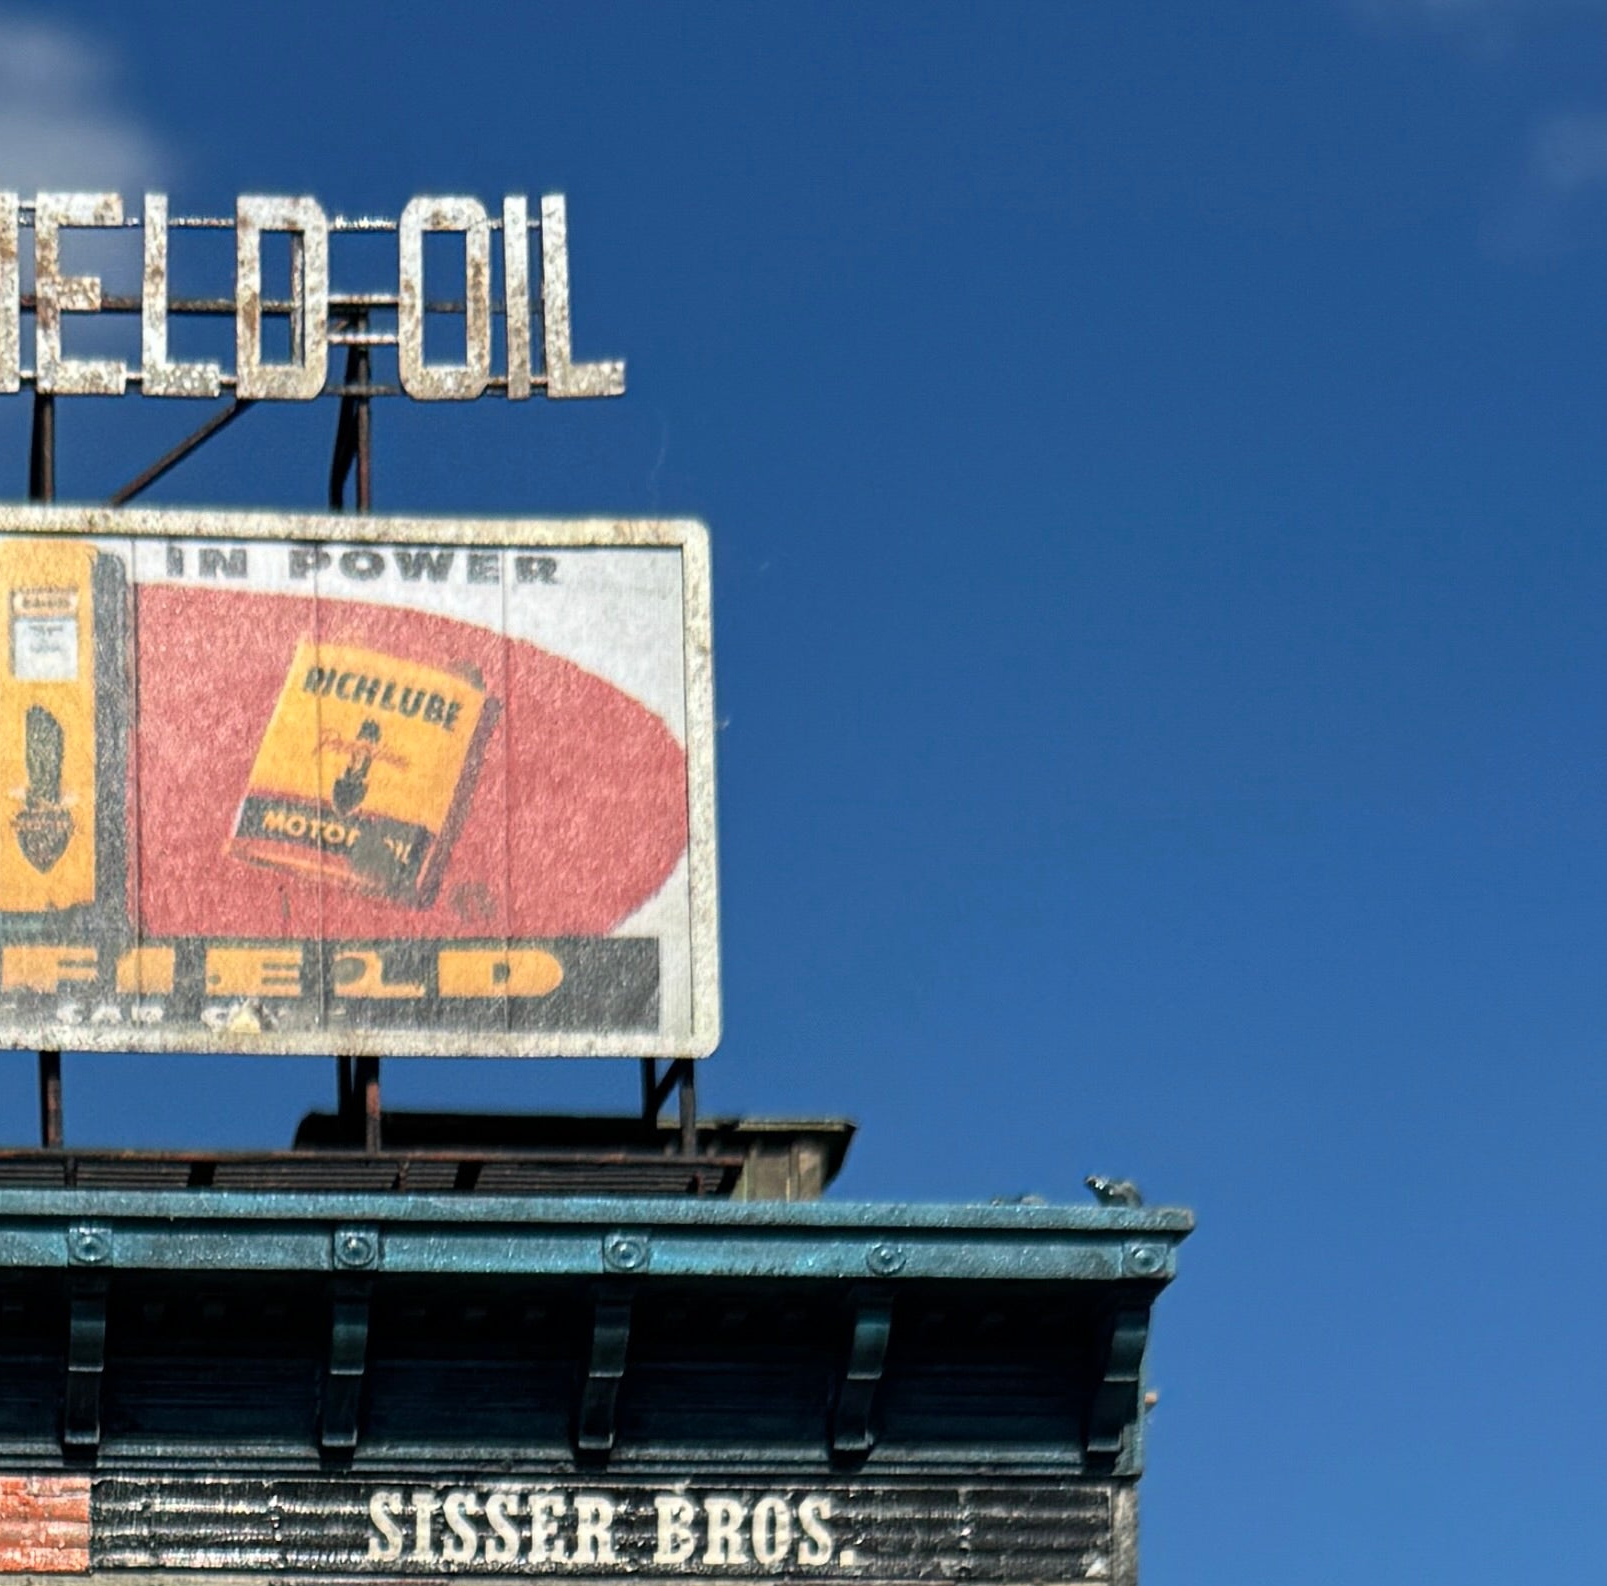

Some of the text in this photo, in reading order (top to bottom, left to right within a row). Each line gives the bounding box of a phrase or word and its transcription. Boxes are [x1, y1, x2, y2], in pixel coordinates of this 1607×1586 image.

[399, 193, 626, 400] OIL
[165, 544, 249, 579] IN
[288, 548, 563, 586] POWER
[367, 1489, 858, 1569] SISSER BROS.
